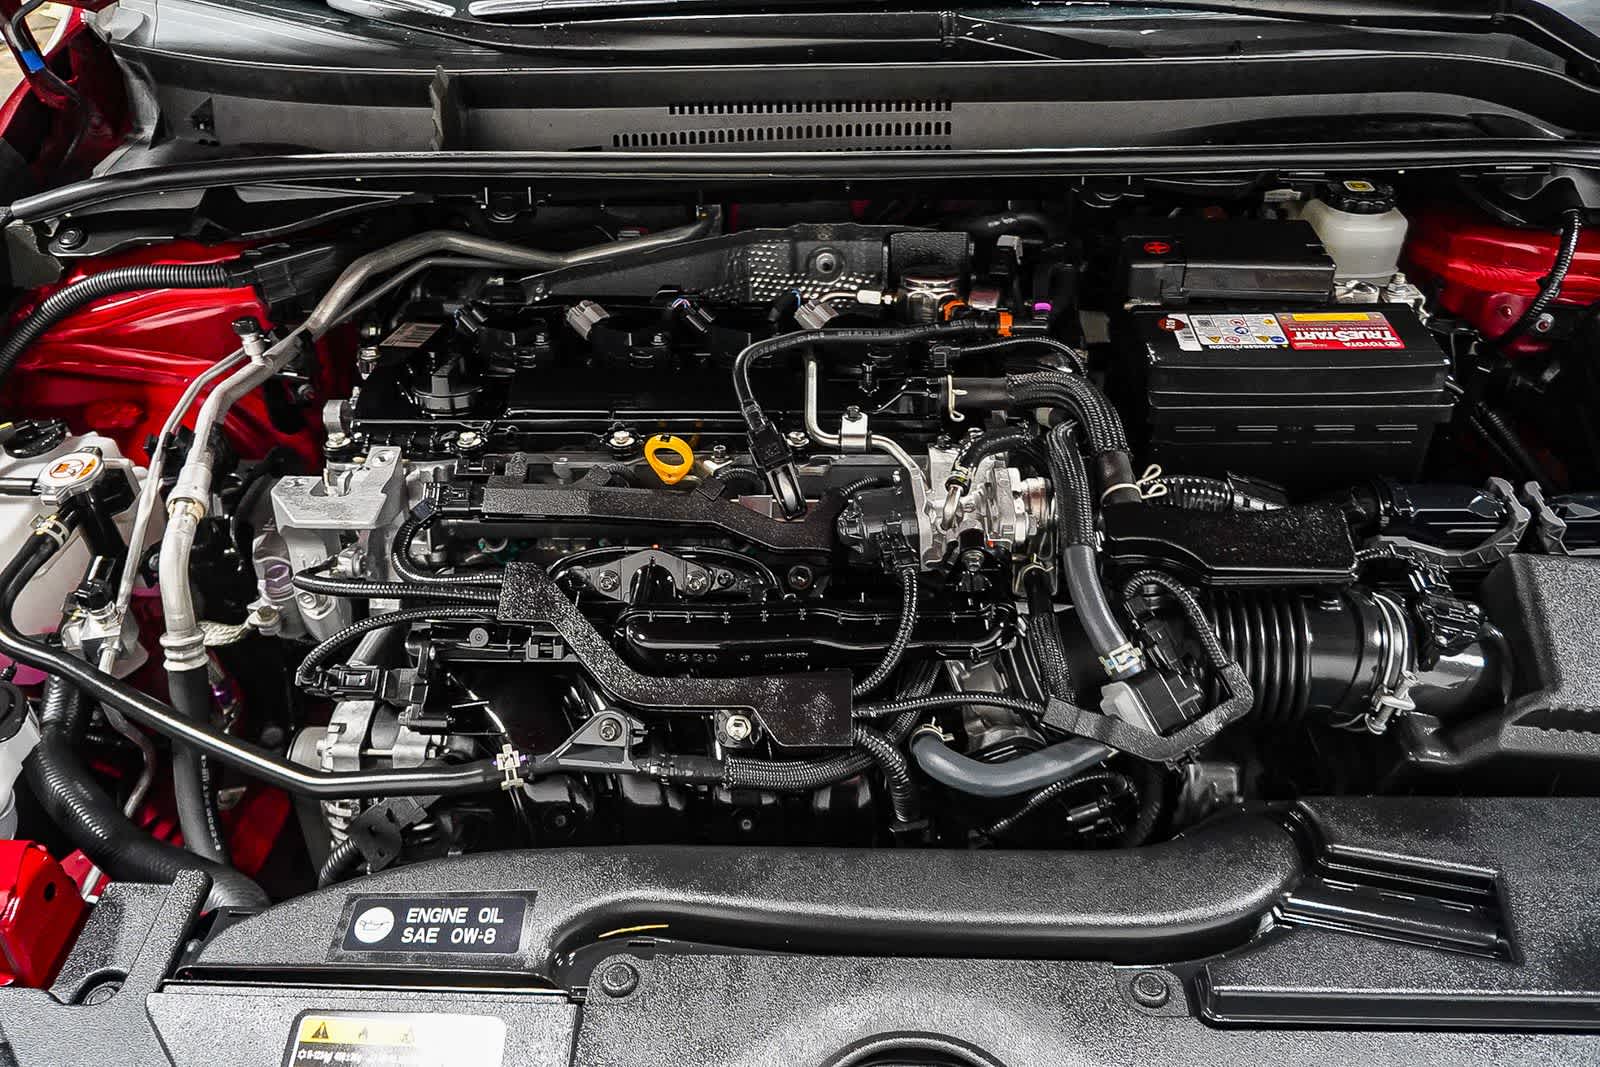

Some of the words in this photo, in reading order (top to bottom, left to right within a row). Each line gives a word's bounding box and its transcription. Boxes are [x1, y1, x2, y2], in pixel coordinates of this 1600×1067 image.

[406, 907, 468, 923] ENGINE
[478, 907, 504, 923] OIL
[401, 927, 440, 943] SAE
[451, 928, 497, 944] 0W-8
